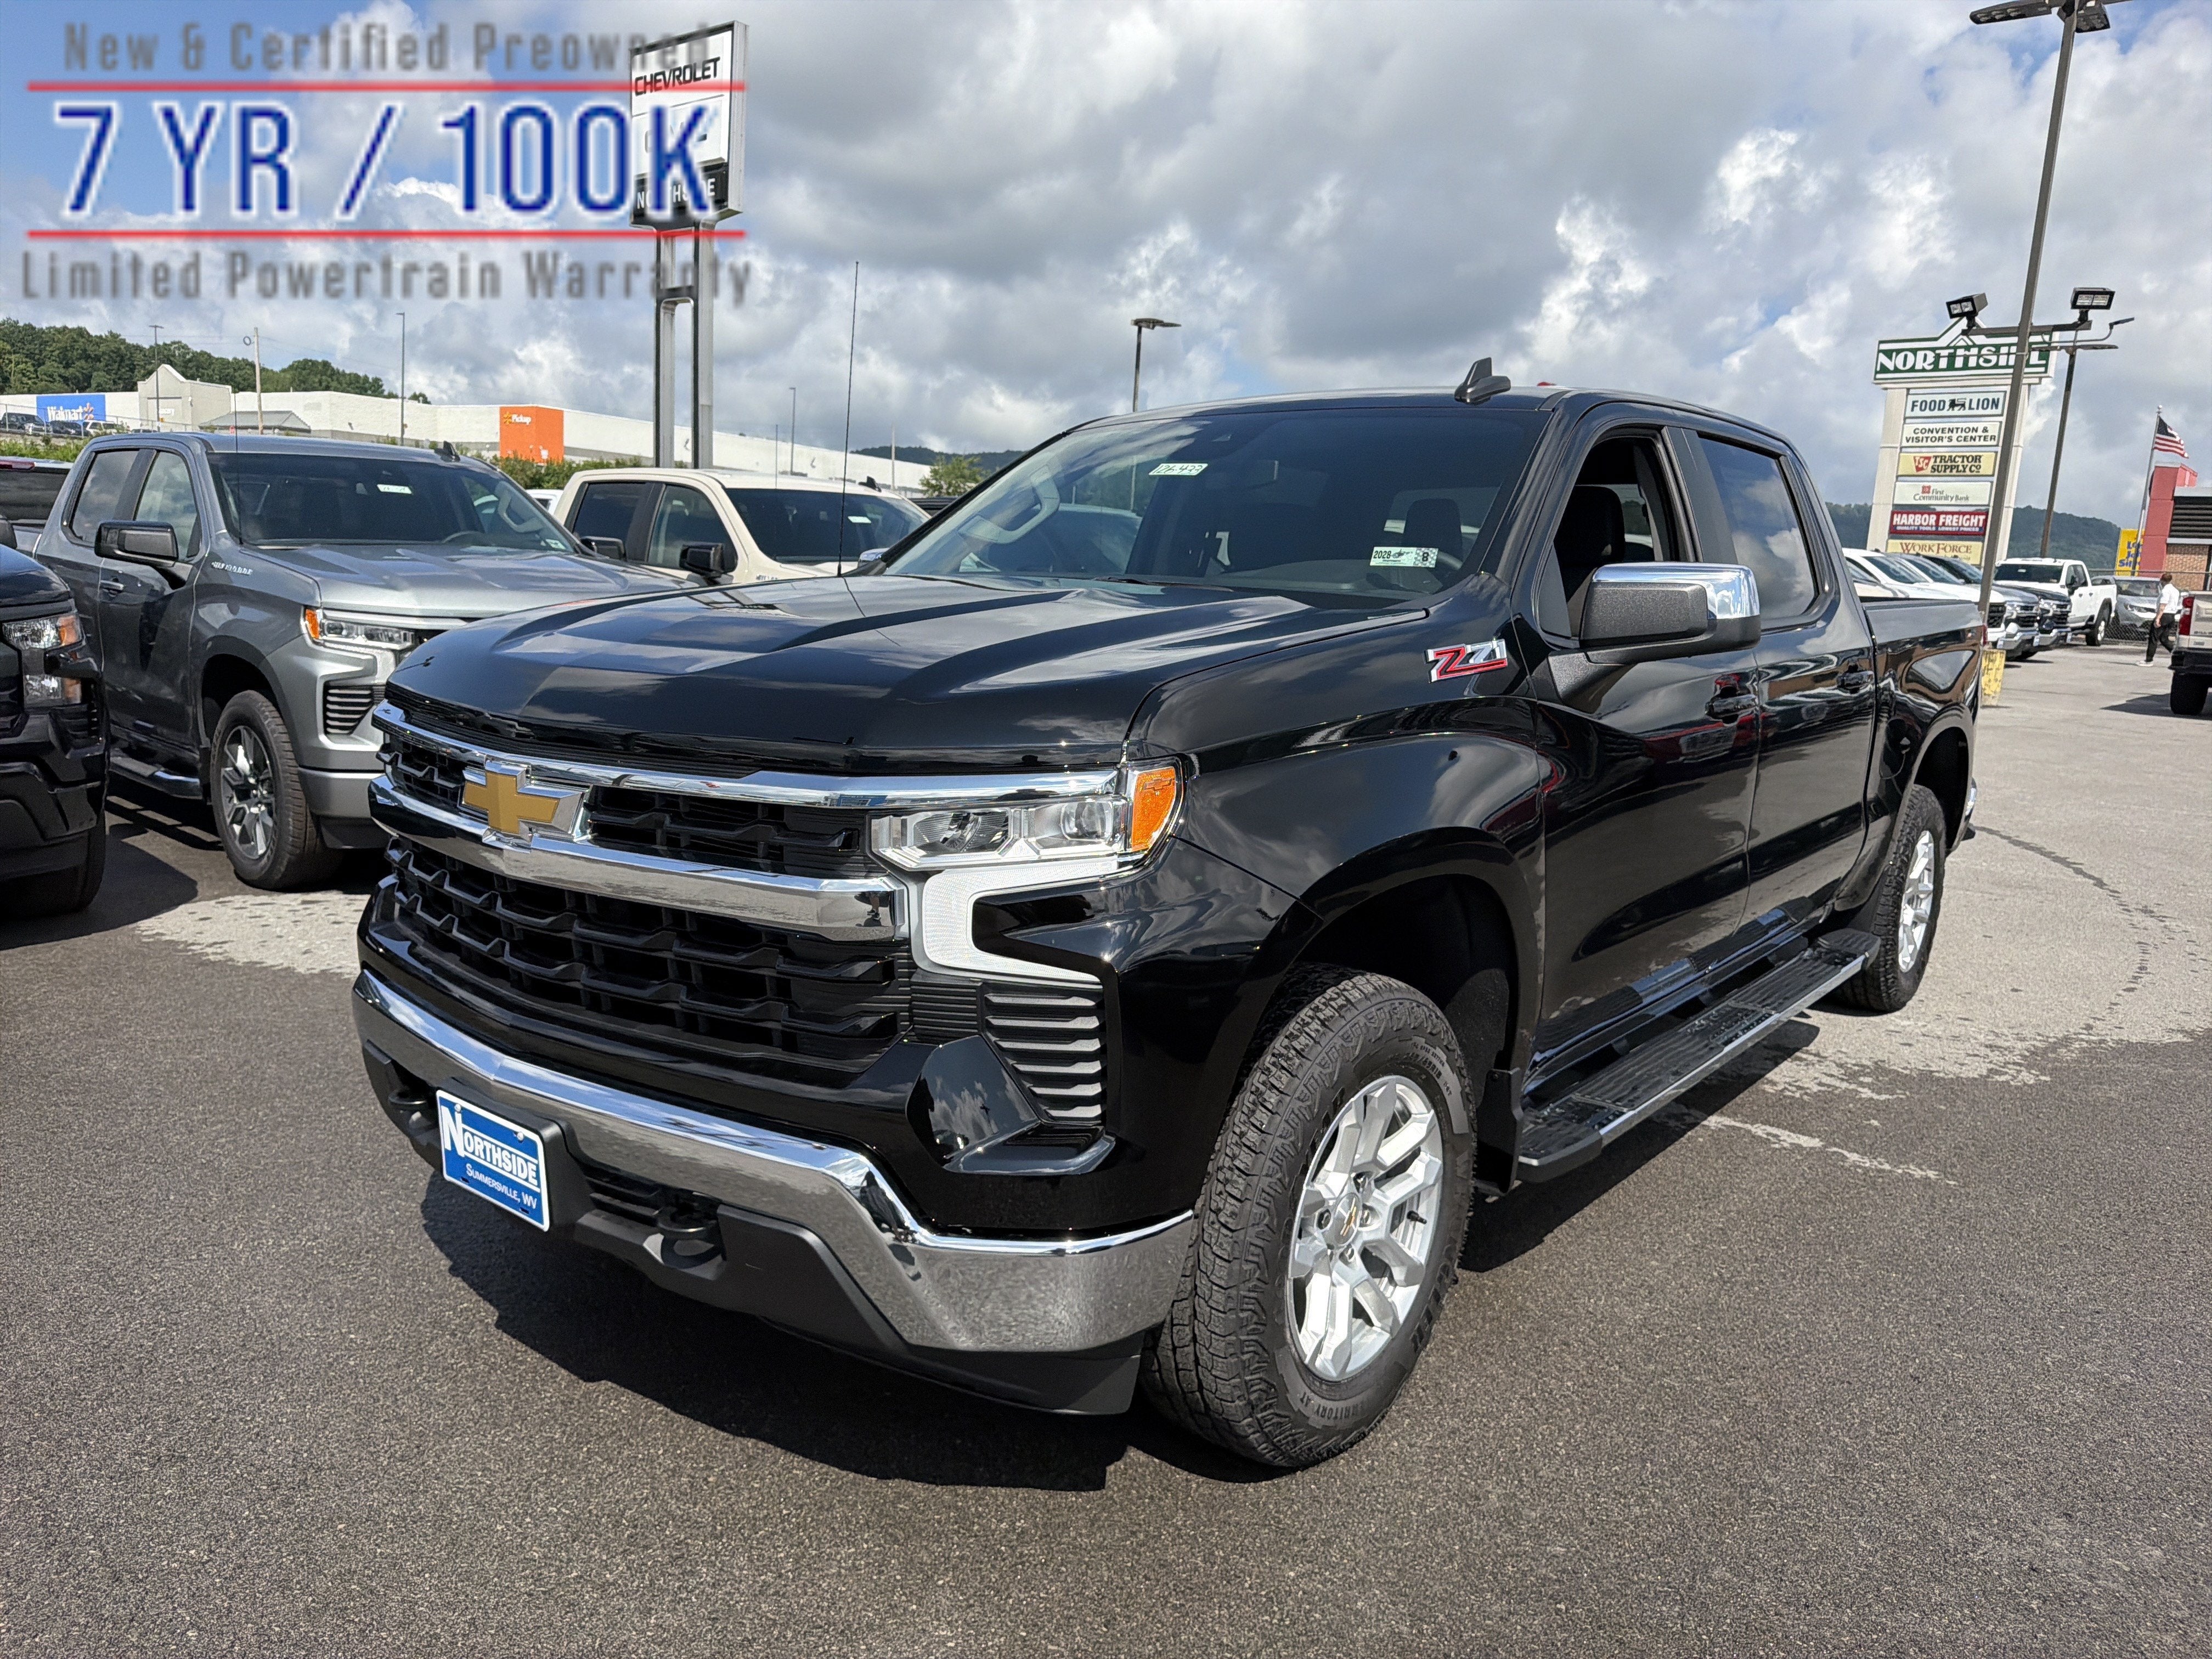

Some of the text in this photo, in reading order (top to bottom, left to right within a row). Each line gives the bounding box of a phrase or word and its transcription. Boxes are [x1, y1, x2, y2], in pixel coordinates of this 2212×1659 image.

[634, 56, 721, 97] CHEVROLET
[1911, 397, 2000, 412] FOOD LION
[47, 405, 83, 421] Walmart
[512, 414, 532, 425] Pickup
[1913, 426, 1989, 435] CONVENTION &
[1905, 435, 1953, 443] VISITOR'S
[1915, 456, 1929, 470] TSC
[1932, 455, 1982, 464] TRACTOR
[1931, 464, 1968, 473] SUPPLY
[1913, 493, 1954, 502] Community
[1893, 513, 1987, 527] HARBOR FREIGHT
[1373, 550, 1430, 562] 2028 8
[441, 1104, 538, 1186] NORTHSIDE
[466, 1163, 538, 1210] SUMMERSVILLE, WV
